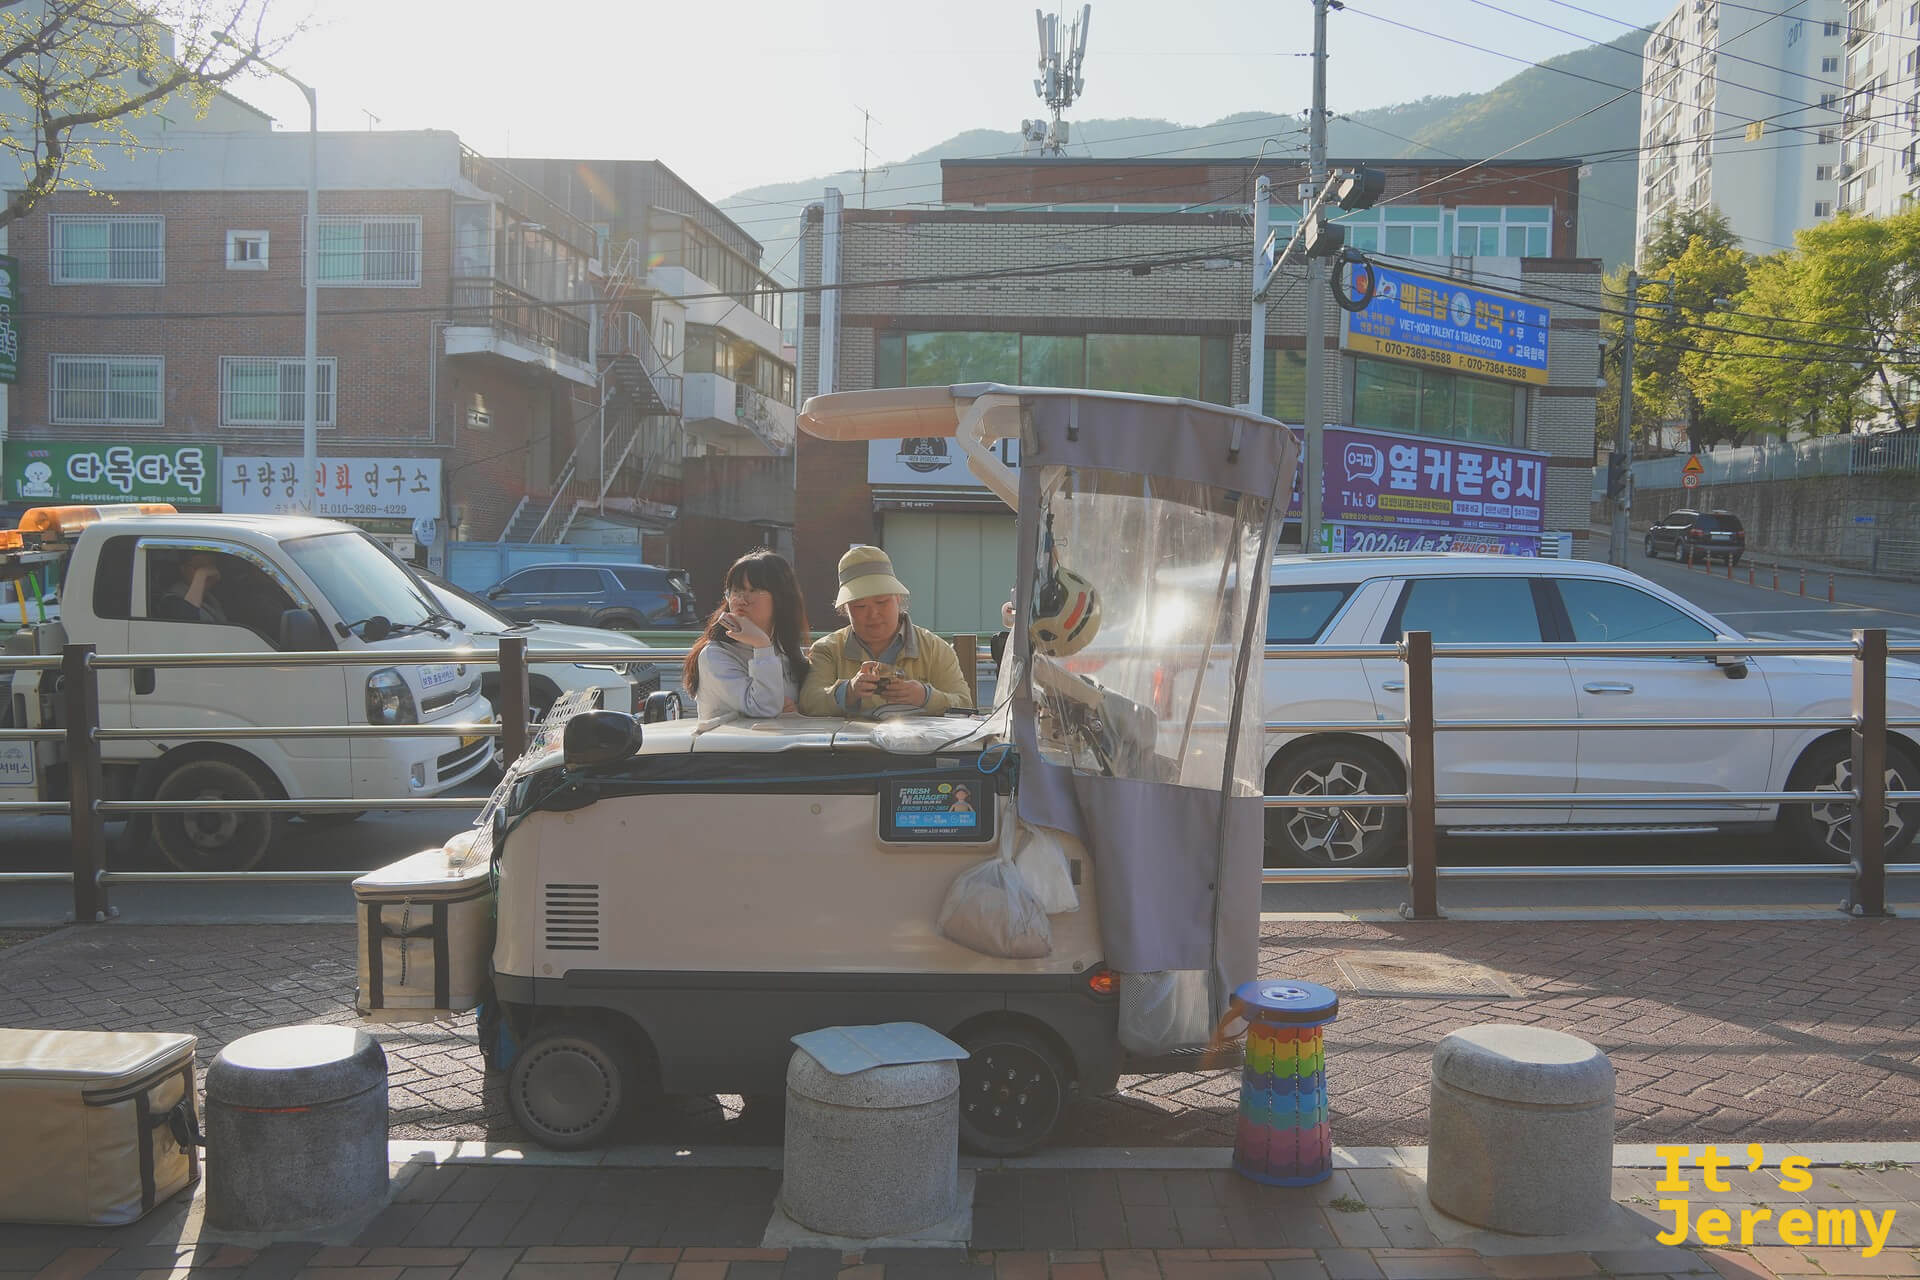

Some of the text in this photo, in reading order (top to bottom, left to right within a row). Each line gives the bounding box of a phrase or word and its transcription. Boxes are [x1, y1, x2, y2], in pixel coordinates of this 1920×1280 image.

[1400, 283, 1504, 334] 베트남 한국
[1400, 318, 1430, 335] VIET-KOR
[1432, 325, 1455, 340] TALENT
[1455, 331, 1461, 341] &
[1461, 332, 1481, 346] TRADE
[1385, 343, 1452, 364] 070-7363-5588
[67, 446, 206, 494] 다독다독
[232, 462, 299, 498] 무량광
[364, 463, 431, 498] 연구소
[1389, 445, 1542, 501] 옆커폰성지
[1686, 476, 1696, 485] 30
[319, 503, 407, 515] H.010-3269-4229
[899, 787, 930, 799] FRESH
[902, 794, 948, 805] MANAGER
